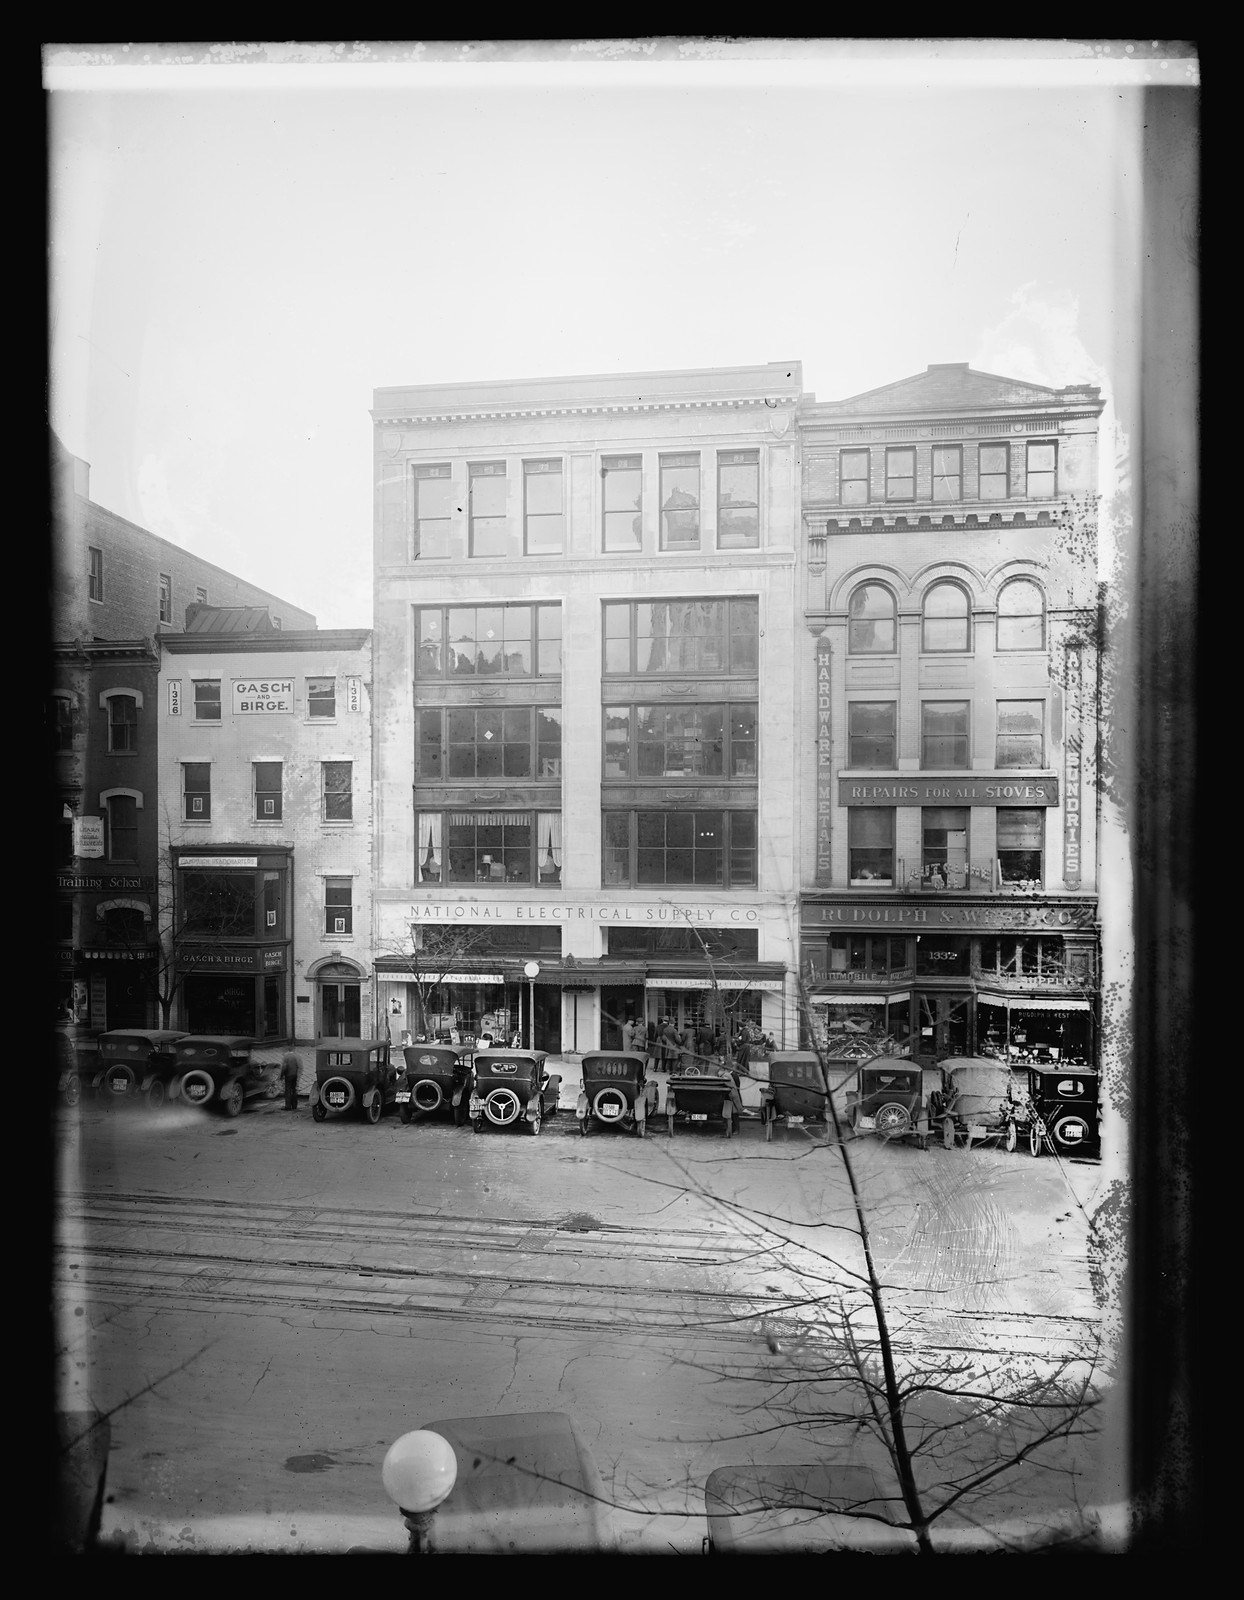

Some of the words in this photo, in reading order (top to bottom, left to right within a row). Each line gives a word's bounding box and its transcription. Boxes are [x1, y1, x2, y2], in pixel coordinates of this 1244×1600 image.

[236, 683, 292, 694] GASCH
[171, 682, 179, 714] 1326
[240, 701, 289, 711] BIRGE.
[818, 653, 831, 766] HARDWARE
[852, 785, 918, 798] REPAIRS
[926, 787, 950, 798] FOR
[955, 787, 979, 798] ALL
[986, 785, 1045, 798] STOVES
[1065, 752, 1079, 873] SUNDRIES
[818, 786, 831, 870] METALS
[57, 876, 103, 889] Training
[109, 877, 142, 888] School
[410, 905, 503, 919] NATIONAL
[517, 906, 631, 920] ELECTRICAL
[646, 908, 715, 921] SUPPLY
[730, 909, 761, 922] CO.
[820, 908, 928, 923] RUDOLPH
[939, 908, 953, 923] &
[183, 955, 214, 963] GASCH
[929, 951, 956, 960] 1332
[265, 959, 282, 967] BIRGE
